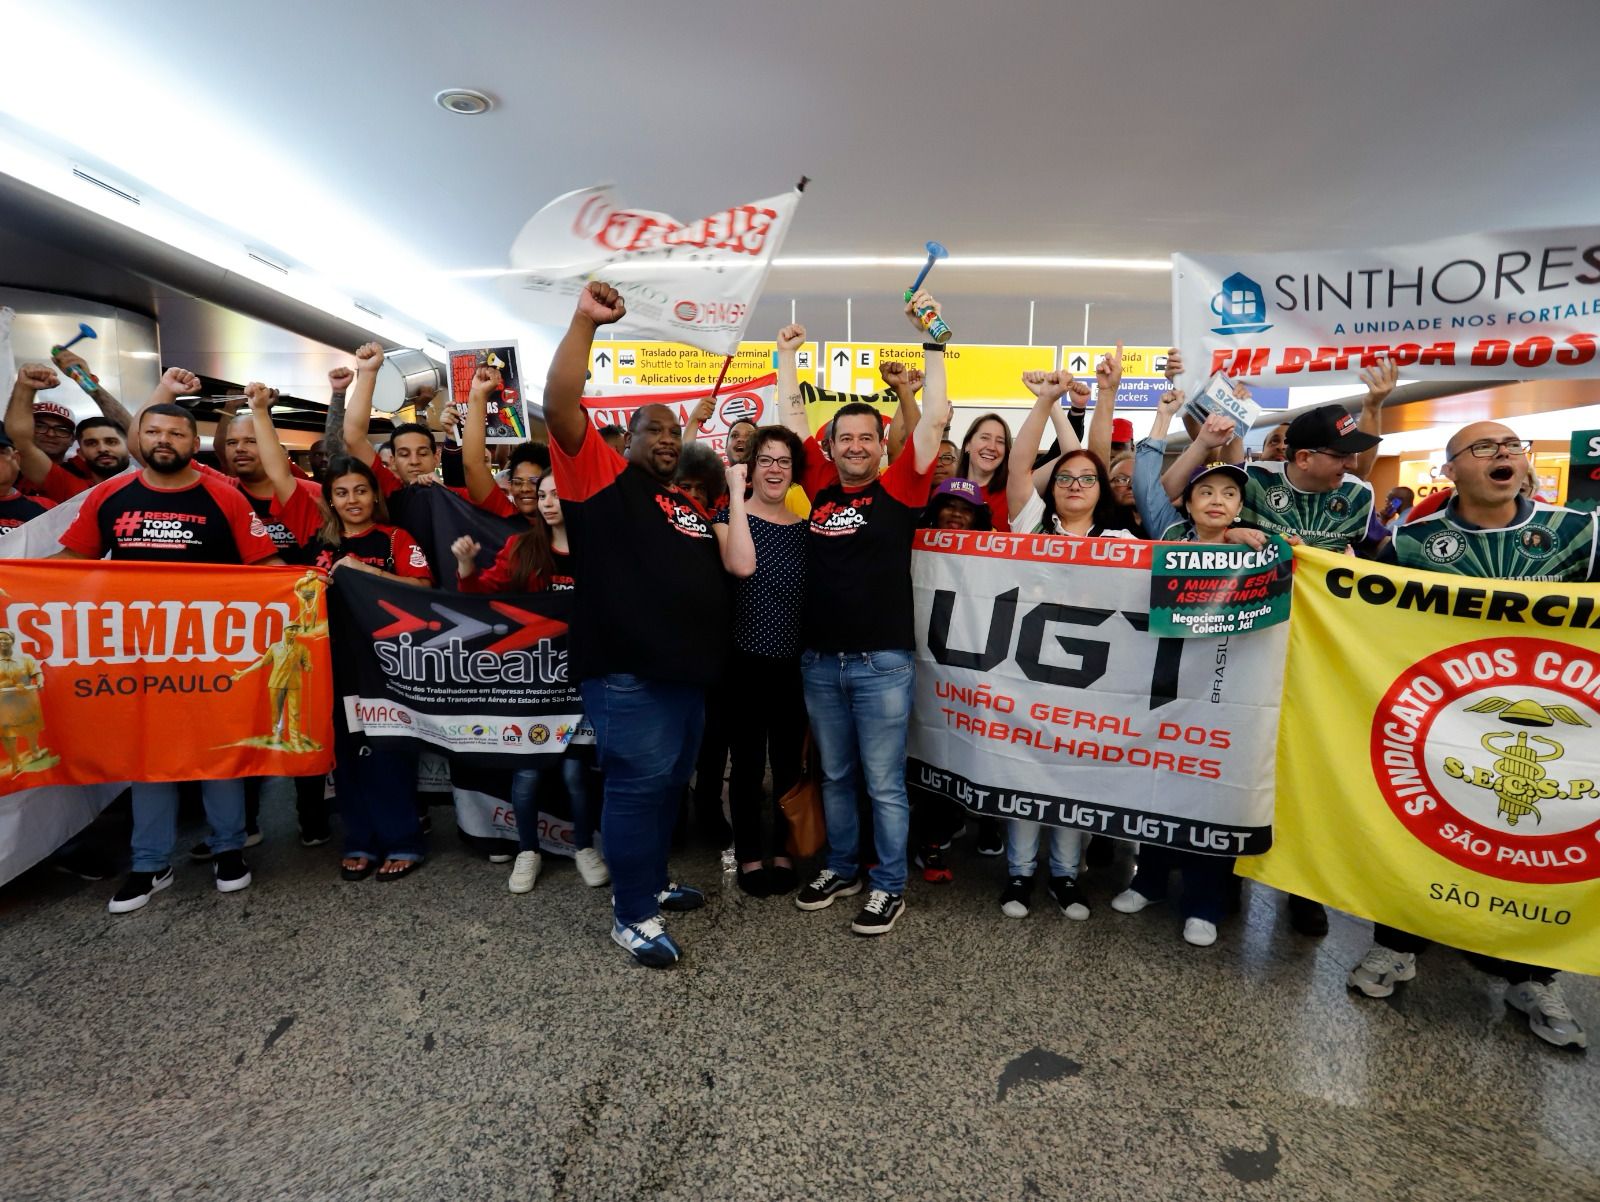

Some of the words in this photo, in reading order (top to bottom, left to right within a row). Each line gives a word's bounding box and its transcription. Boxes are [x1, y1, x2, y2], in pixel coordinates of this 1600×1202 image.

[1334, 323, 1345, 335] A
[1355, 318, 1442, 334] UNIDADE
[1451, 314, 1496, 328] NOS
[641, 348, 676, 357] Traslado
[680, 350, 698, 359] para
[641, 360, 672, 368] Shuttle
[687, 360, 706, 368] Train
[861, 353, 870, 366] E
[1470, 333, 1598, 368] DOS
[641, 374, 692, 384] Aplicativos
[694, 374, 706, 382] de
[142, 528, 194, 539] MUNDO
[144, 520, 182, 530] TODO
[924, 529, 967, 552] UGT
[976, 535, 1024, 556] UGT
[1032, 538, 1082, 561] UGT
[1091, 543, 1150, 564] UGT
[1166, 544, 1278, 570] STARBUCKS:
[1168, 579, 1178, 590] O
[1184, 578, 1238, 590] MUNDO
[1326, 568, 1600, 630] COMERCI
[1172, 613, 1224, 626] Negociem
[1238, 605, 1272, 620] Acordo
[1192, 624, 1234, 634] Coletivo
[1238, 618, 1254, 631] Já!
[14, 603, 286, 661] SIEMACO
[928, 587, 1184, 711] UGT
[1212, 636, 1228, 704] BRASIL
[74, 674, 138, 698] SÃO
[144, 674, 233, 694] PAULO
[936, 682, 1016, 714] UNIÃO
[1030, 703, 1142, 738] GERAL
[1158, 722, 1232, 750] DOS
[940, 708, 1222, 780] TRABALHADORES
[1383, 675, 1444, 816] SINDICATO
[1442, 649, 1518, 688] DOS
[920, 766, 952, 794] UGT
[957, 781, 991, 810] UGT
[998, 792, 1052, 820] UGT
[1059, 803, 1116, 832] UGT
[1123, 814, 1180, 843] UGT
[1189, 826, 1253, 853] UGT
[1438, 823, 1492, 856] SÃO
[1496, 846, 1588, 868] PAULO
[1429, 883, 1480, 908] SÃO
[1489, 896, 1572, 926] PAULO
